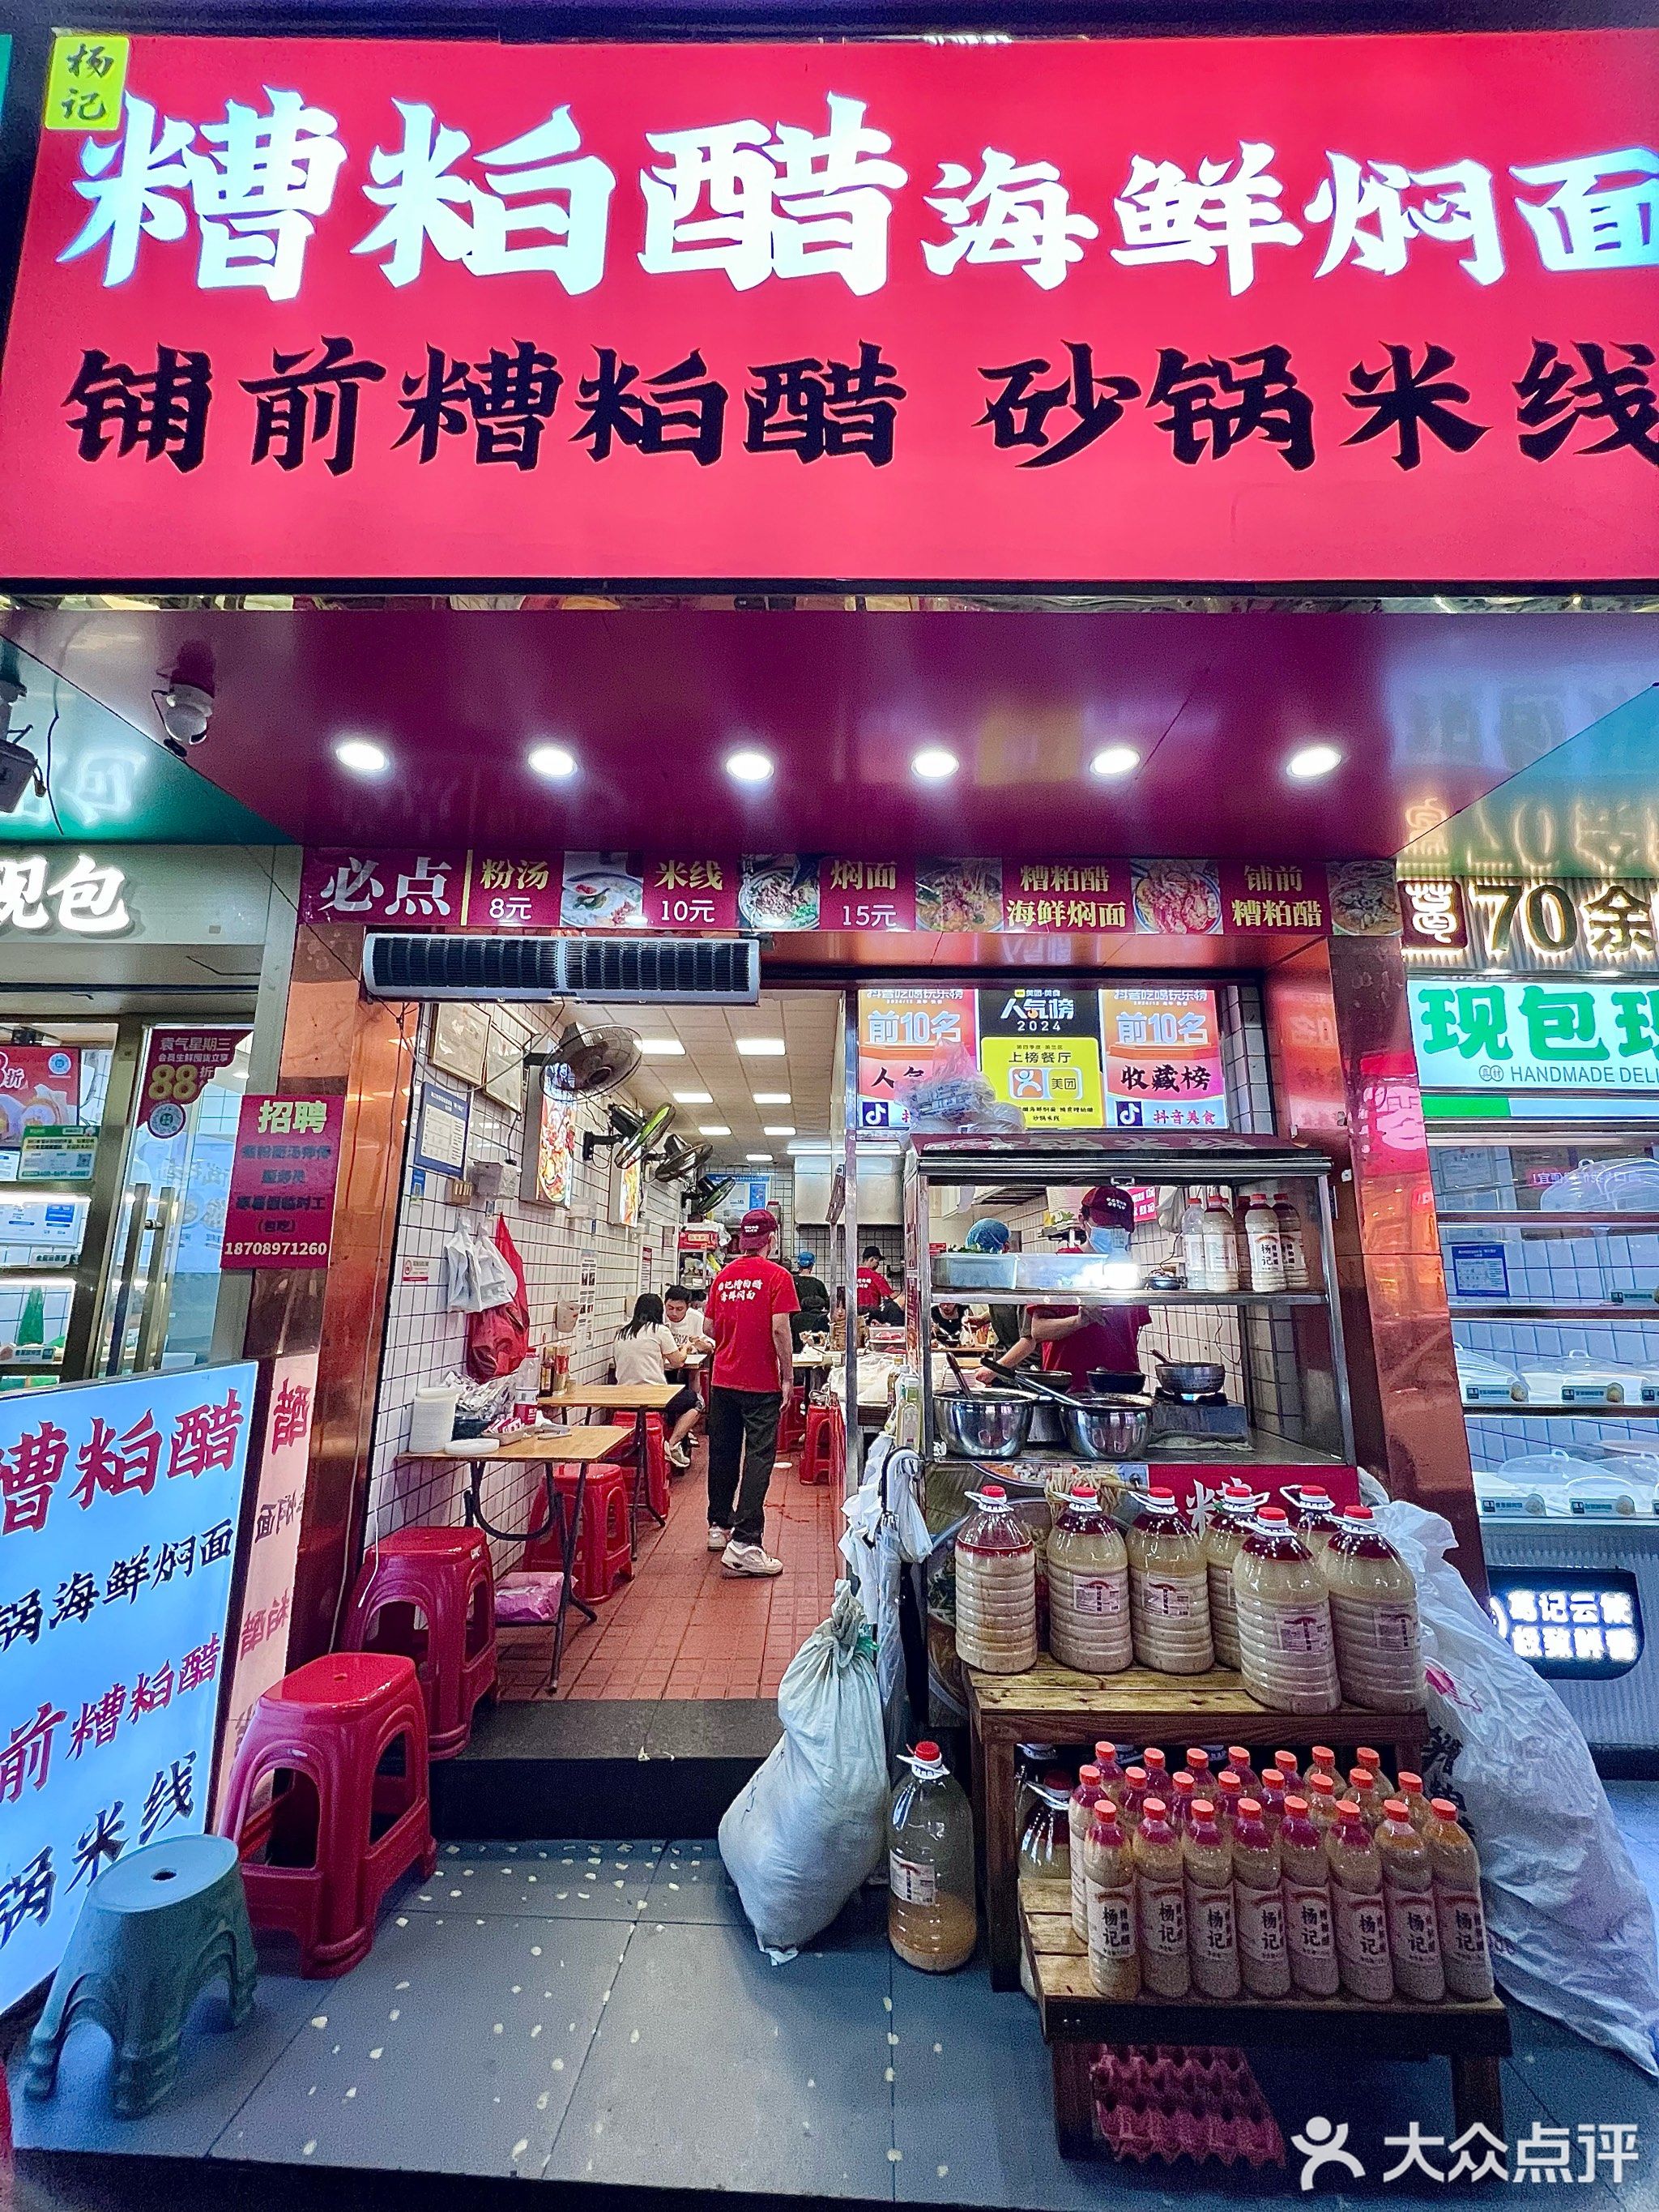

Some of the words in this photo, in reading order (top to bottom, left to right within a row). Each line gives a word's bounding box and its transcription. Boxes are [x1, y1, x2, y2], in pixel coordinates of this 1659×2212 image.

[61, 41, 115, 122] 杨记
[62, 335, 907, 476] 铺前糟粕醋
[970, 337, 1659, 472] 砂锅米线
[318, 856, 452, 916] 必点
[480, 859, 549, 890] 粉汤
[655, 860, 723, 890] 米线
[830, 860, 897, 892] 焖面
[1020, 864, 1110, 893] 糟粕醋
[1244, 865, 1303, 892] 铺前
[488, 899, 532, 920] 8元
[661, 900, 715, 923] 10元
[842, 903, 897, 927] 15元
[1007, 899, 1127, 929] 海鲜焖面
[1231, 899, 1323, 929] 糟粕醋
[1000, 997, 1075, 1020] 人气榜
[868, 1010, 962, 1044] 前10名
[1017, 1021, 1061, 1031] 2024
[1116, 1011, 1209, 1044] 前10名
[1009, 1052, 1072, 1064] 上榜餐厅
[148, 1064, 198, 1100] 88
[1051, 1078, 1077, 1090] 美团
[1121, 1064, 1211, 1092] 收藏榜
[1511, 1066, 1615, 1083] HANDMADE
[258, 1100, 327, 1134] 招聘
[1154, 1109, 1215, 1125] 抖音美食
[224, 1242, 327, 1256] 18708971260
[1261, 1244, 1273, 1266] 杨记
[1102, 1906, 1120, 1946] 杨记
[1158, 1902, 1177, 1943] 杨记
[1207, 1908, 1225, 1949] 杨记
[1262, 1909, 1280, 1950] 杨记
[1301, 1906, 1321, 1946] 杨记
[1360, 1914, 1378, 1955] 杨记
[1407, 1911, 1427, 1954] 杨记
[1455, 1909, 1476, 1952] 杨记
